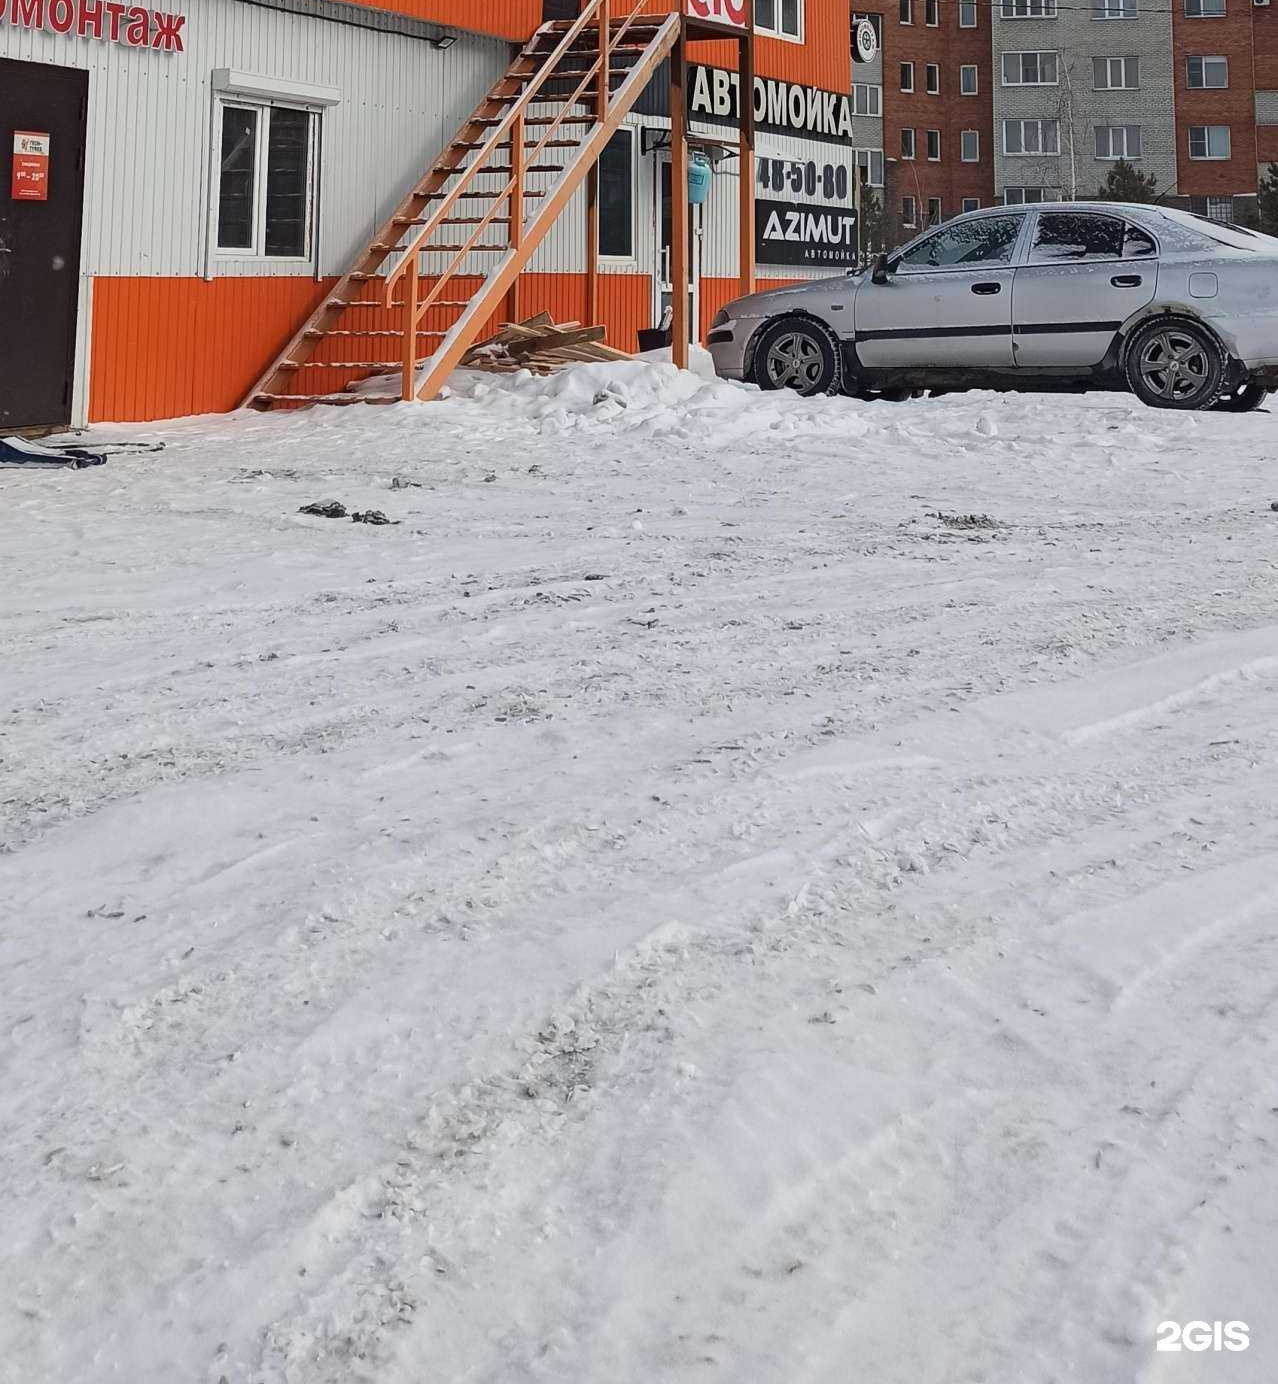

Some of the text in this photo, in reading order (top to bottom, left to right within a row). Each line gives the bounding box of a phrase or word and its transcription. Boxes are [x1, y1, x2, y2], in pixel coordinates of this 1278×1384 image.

[691, 65, 853, 138] АВТОМОЙКА
[762, 209, 856, 245] AZIMUT
[804, 248, 856, 261] АВТОМОЙКА
